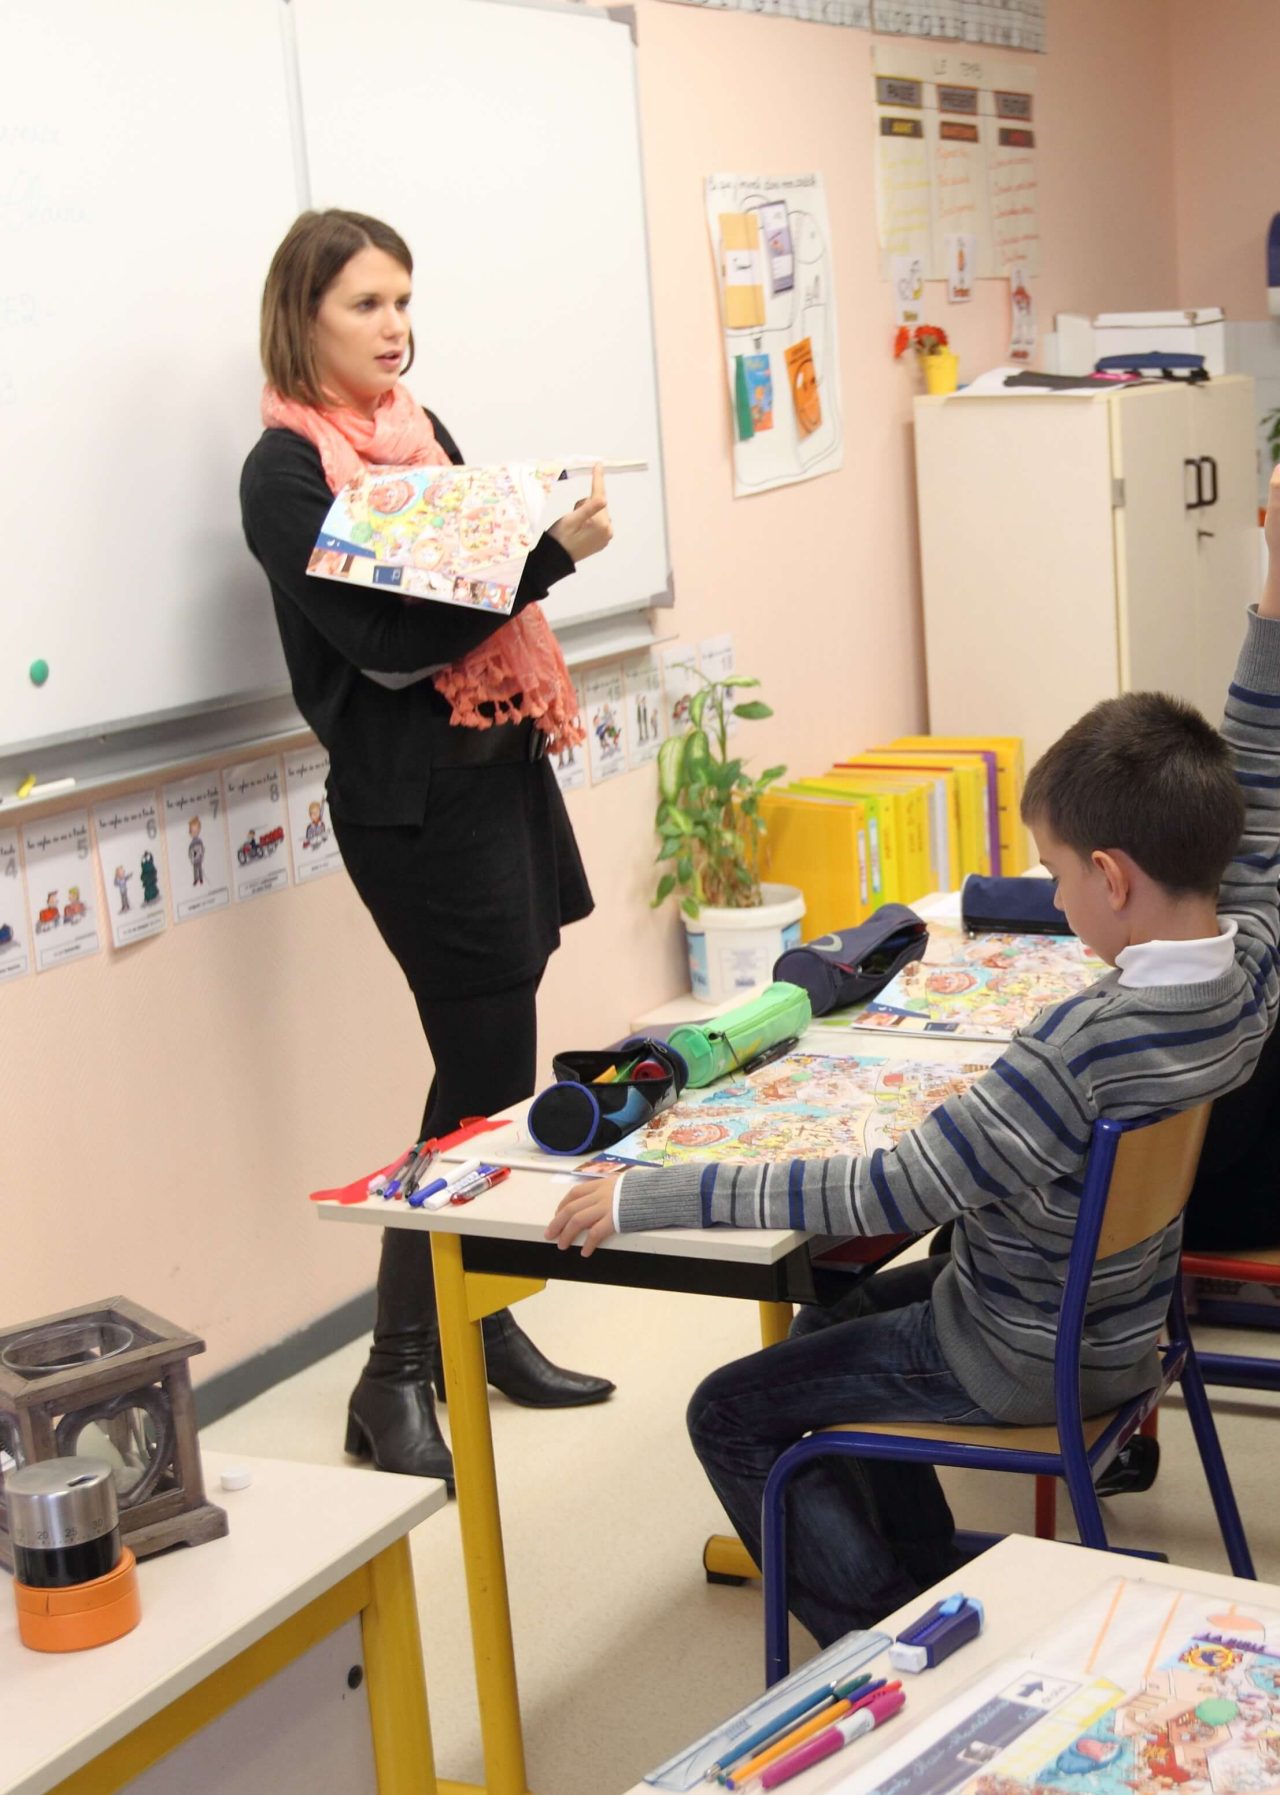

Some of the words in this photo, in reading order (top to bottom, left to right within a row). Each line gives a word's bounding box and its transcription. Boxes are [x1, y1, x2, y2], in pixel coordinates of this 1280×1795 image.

[270, 782, 280, 802] 8
[209, 799, 219, 819] 7
[146, 818, 157, 840] 6
[77, 838, 89, 860] 5
[5, 857, 18, 879] 4
[36, 1531, 49, 1540] 20
[64, 1528, 78, 1537] 25
[92, 1518, 104, 1529] 30
